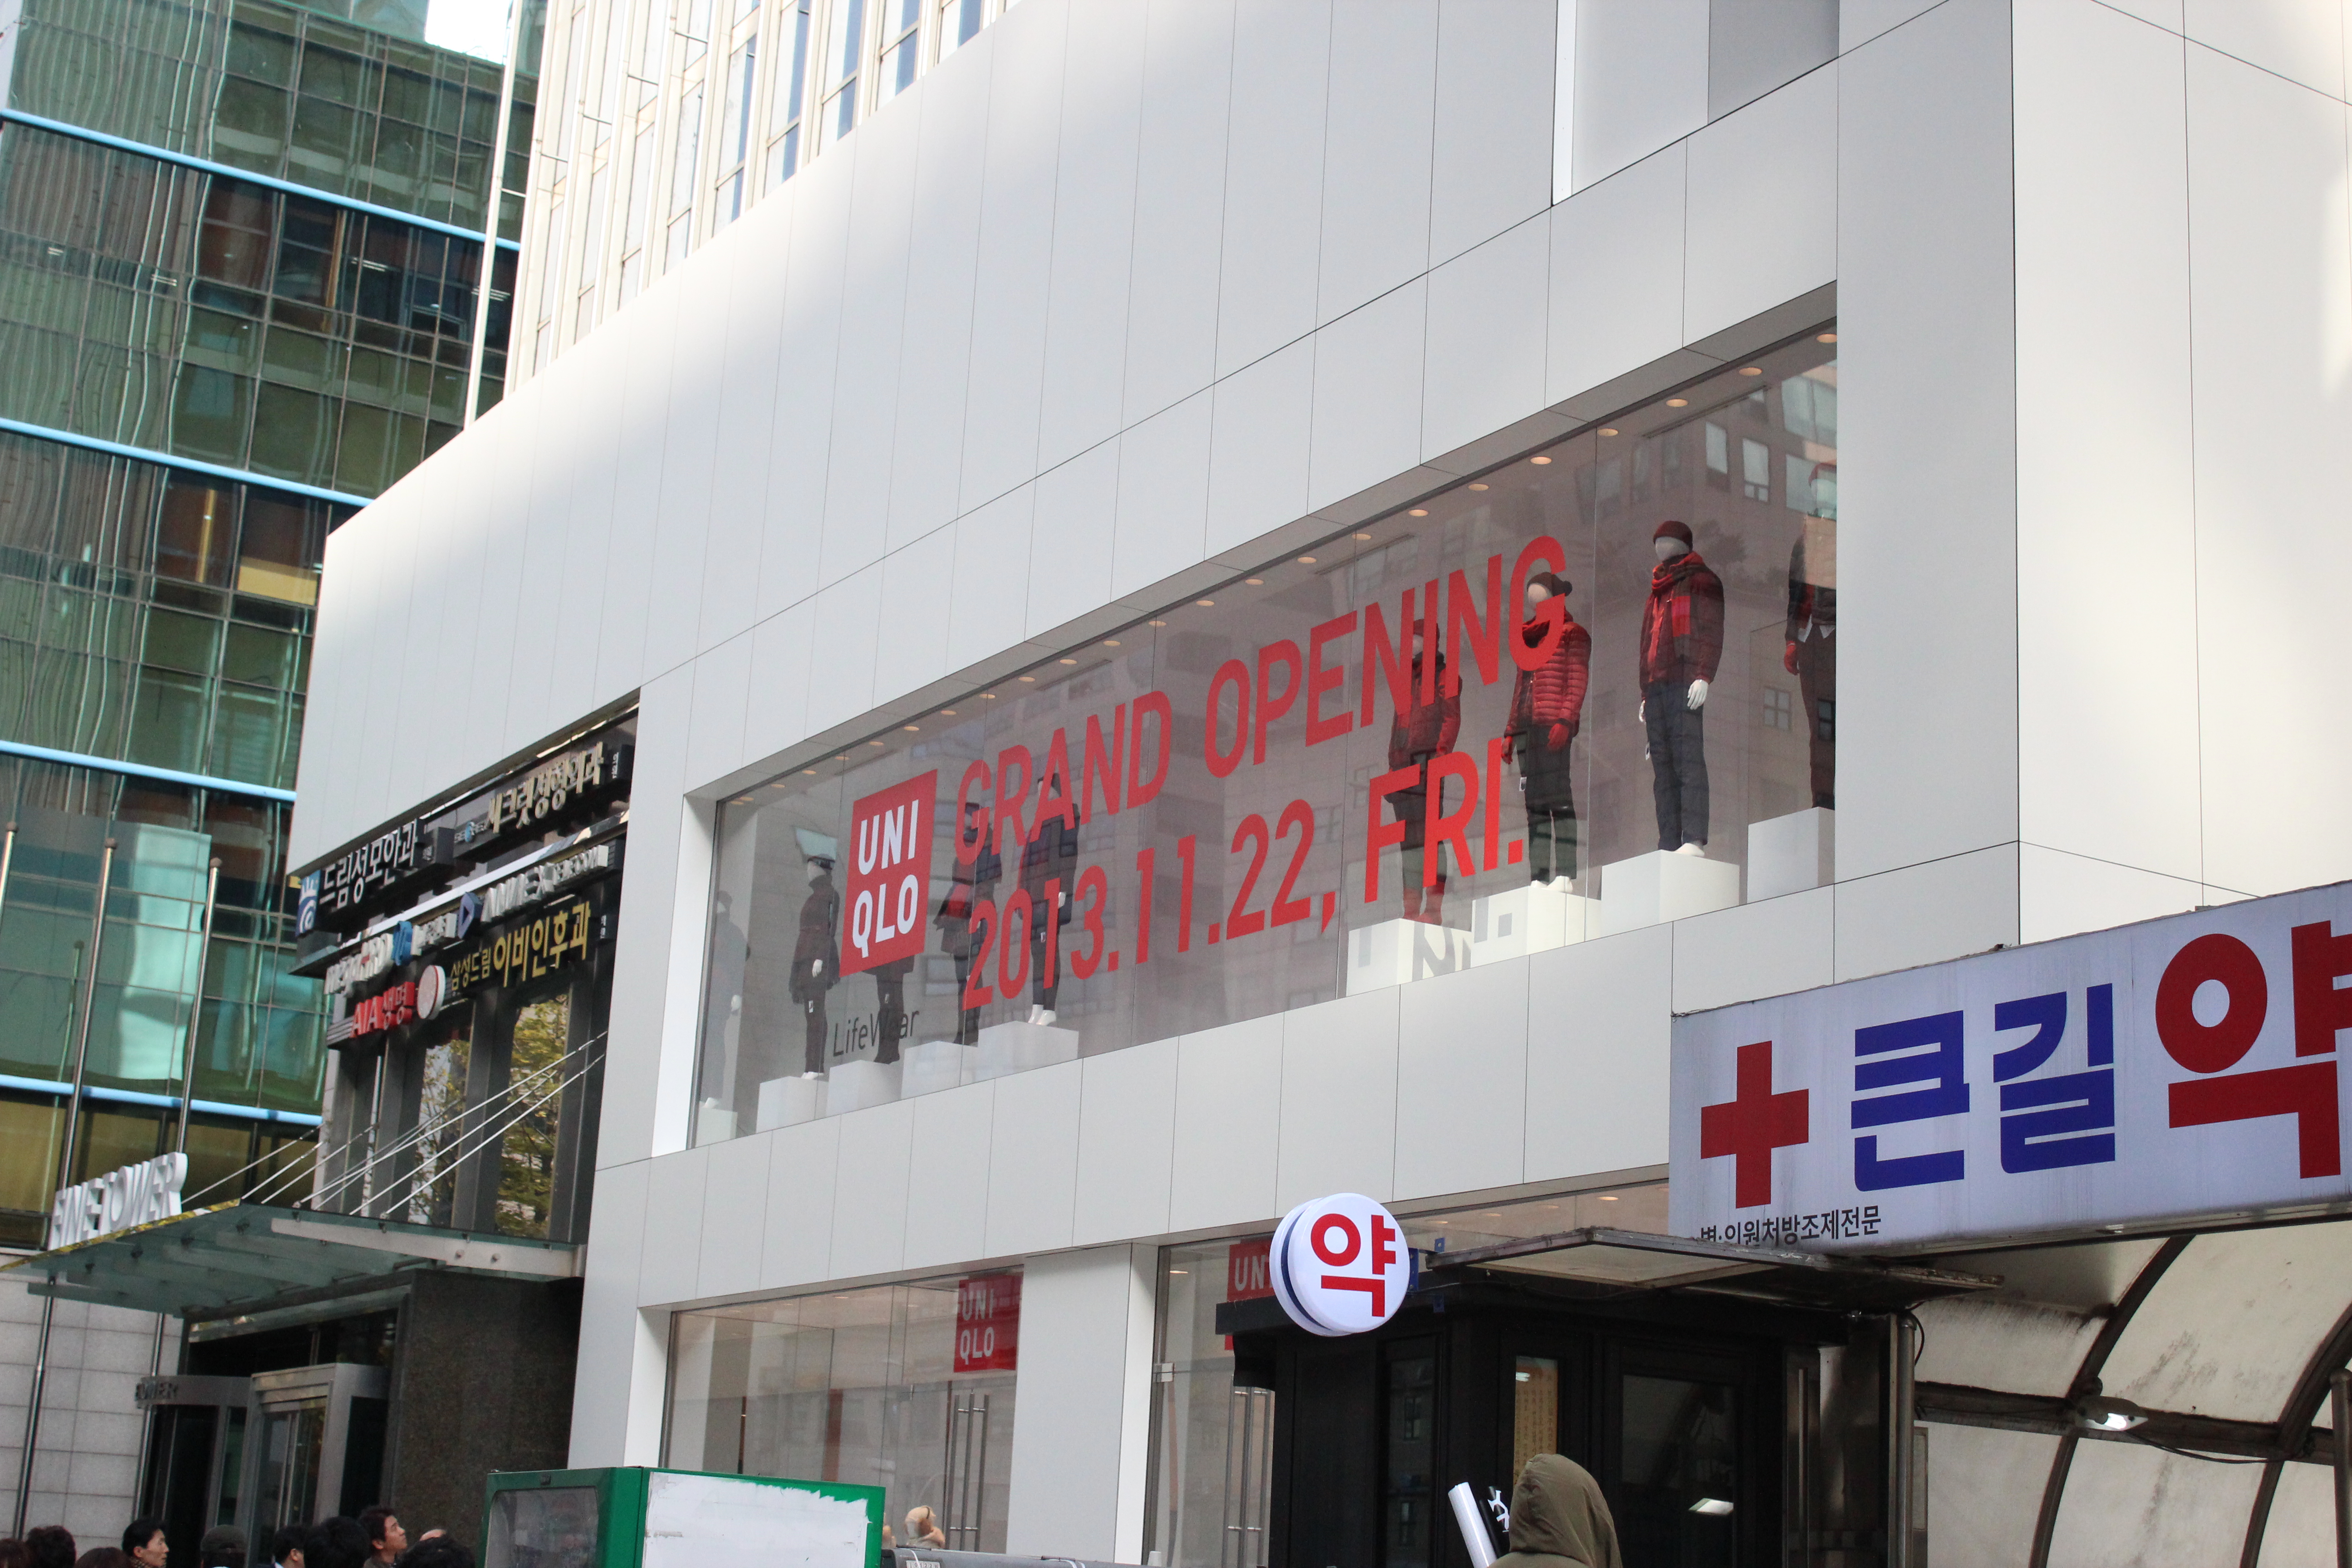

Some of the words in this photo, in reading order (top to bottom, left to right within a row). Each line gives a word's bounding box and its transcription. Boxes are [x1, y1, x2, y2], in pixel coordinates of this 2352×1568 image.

[956, 691, 1171, 866] GRAND
[1205, 536, 1566, 778] OPENING
[319, 818, 418, 909] 드림성모안과
[858, 799, 919, 875] UNI
[963, 800, 1335, 1010] 2013.11.22,
[1365, 736, 1523, 902] FRI.
[493, 901, 591, 988] 이비인후과
[852, 874, 918, 958] QLO
[833, 1010, 920, 1057] LifeWar
[961, 1288, 995, 1321] UNI
[1234, 1254, 1270, 1291] UN
[1310, 1213, 1396, 1317] 약
[960, 1327, 995, 1365] QLO
